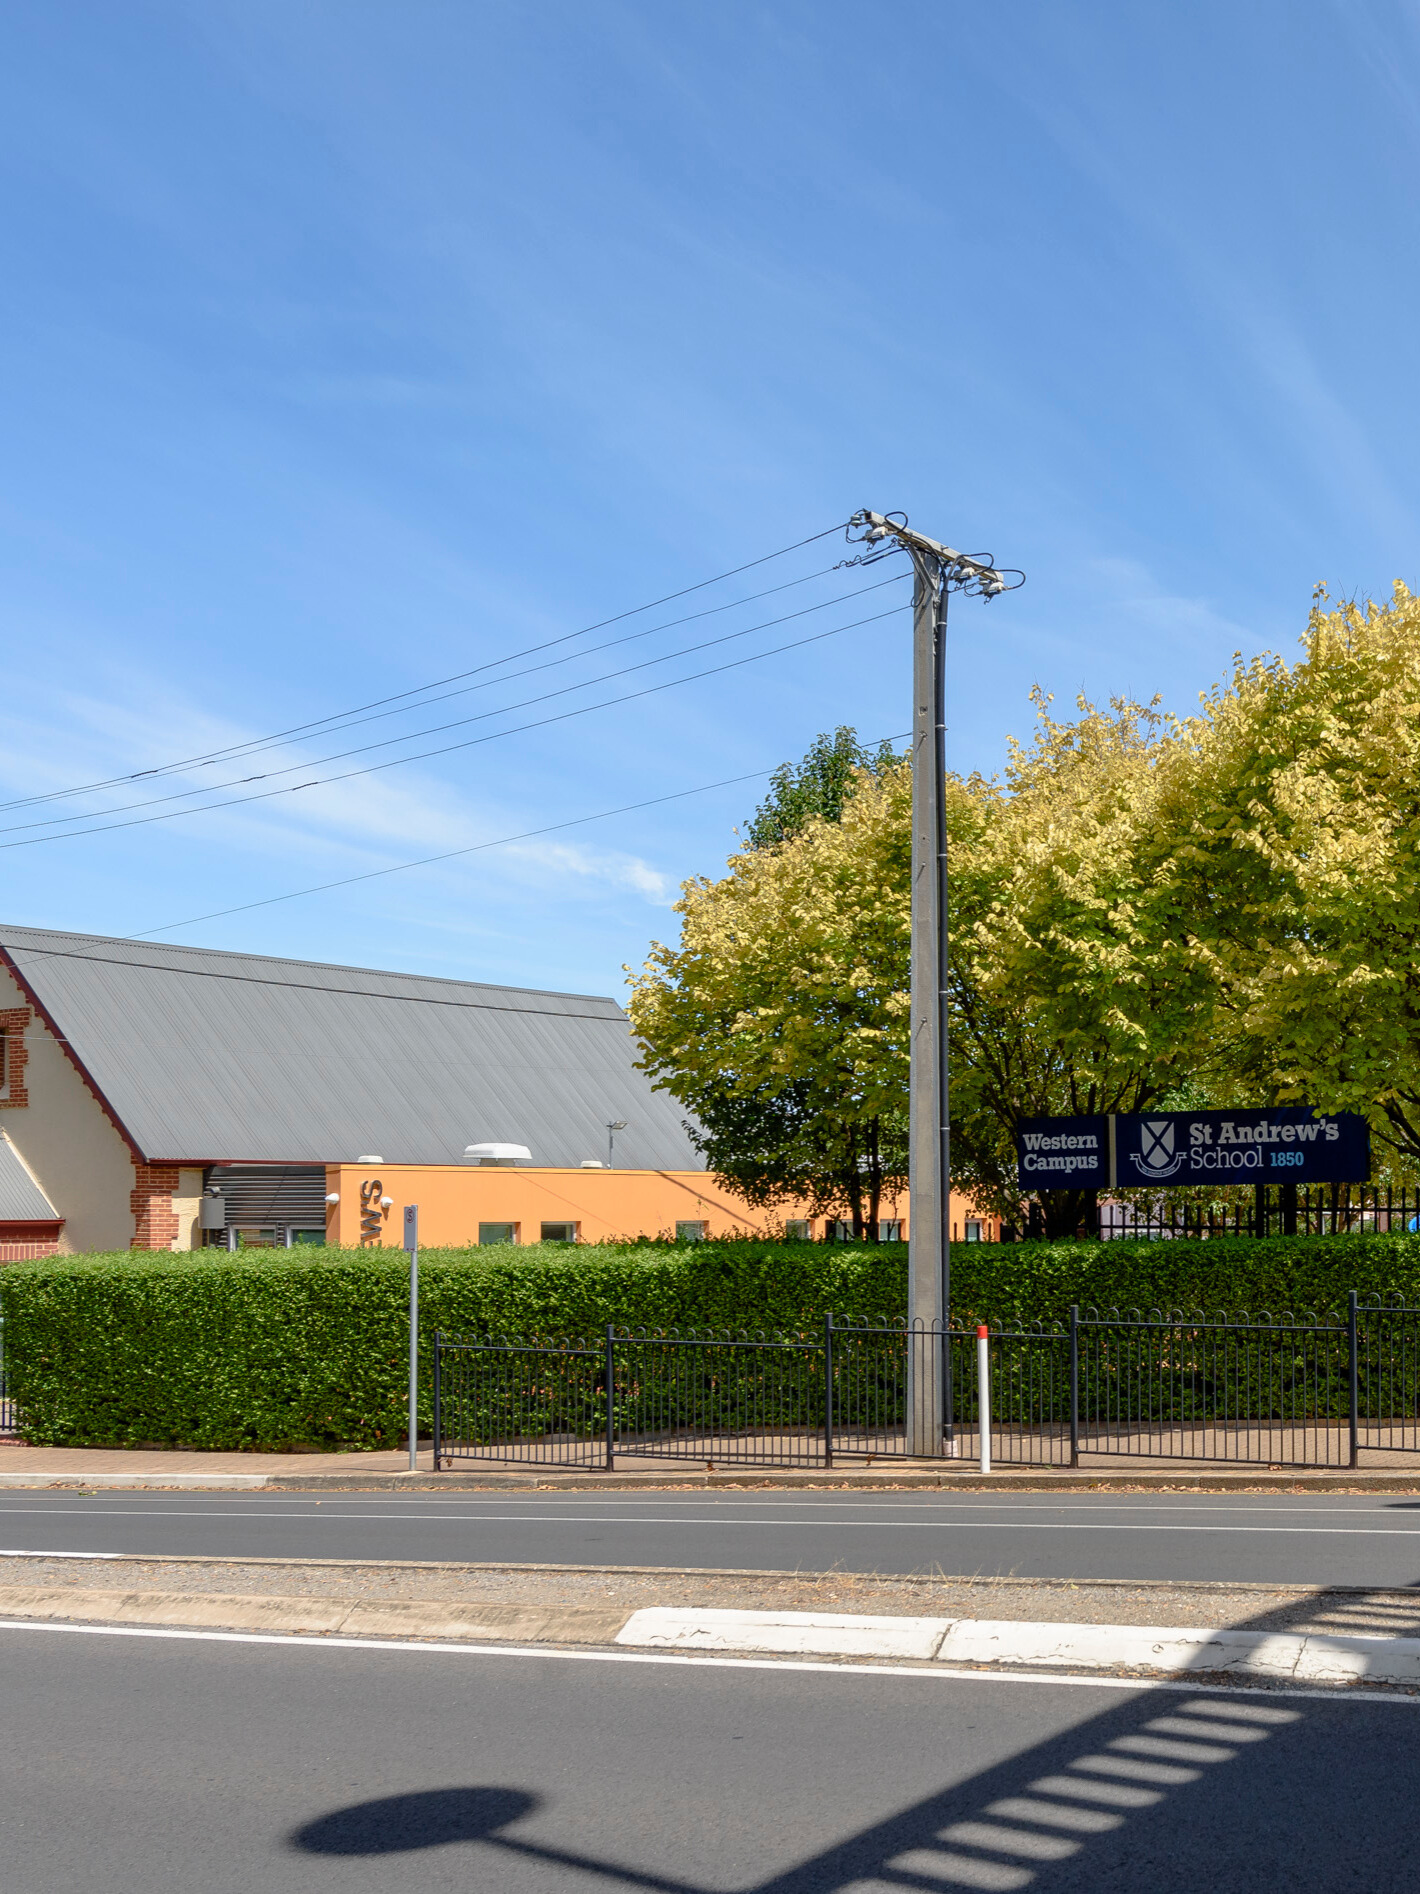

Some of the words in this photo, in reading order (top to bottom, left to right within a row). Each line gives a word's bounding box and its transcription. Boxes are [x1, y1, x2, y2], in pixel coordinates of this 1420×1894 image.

[1022, 1133, 1098, 1150] Western
[1189, 1122, 1213, 1145] St
[1217, 1119, 1340, 1144] Andrew's
[1023, 1153, 1099, 1173] Campus
[1190, 1145, 1264, 1169] School
[1270, 1152, 1304, 1166] 1850
